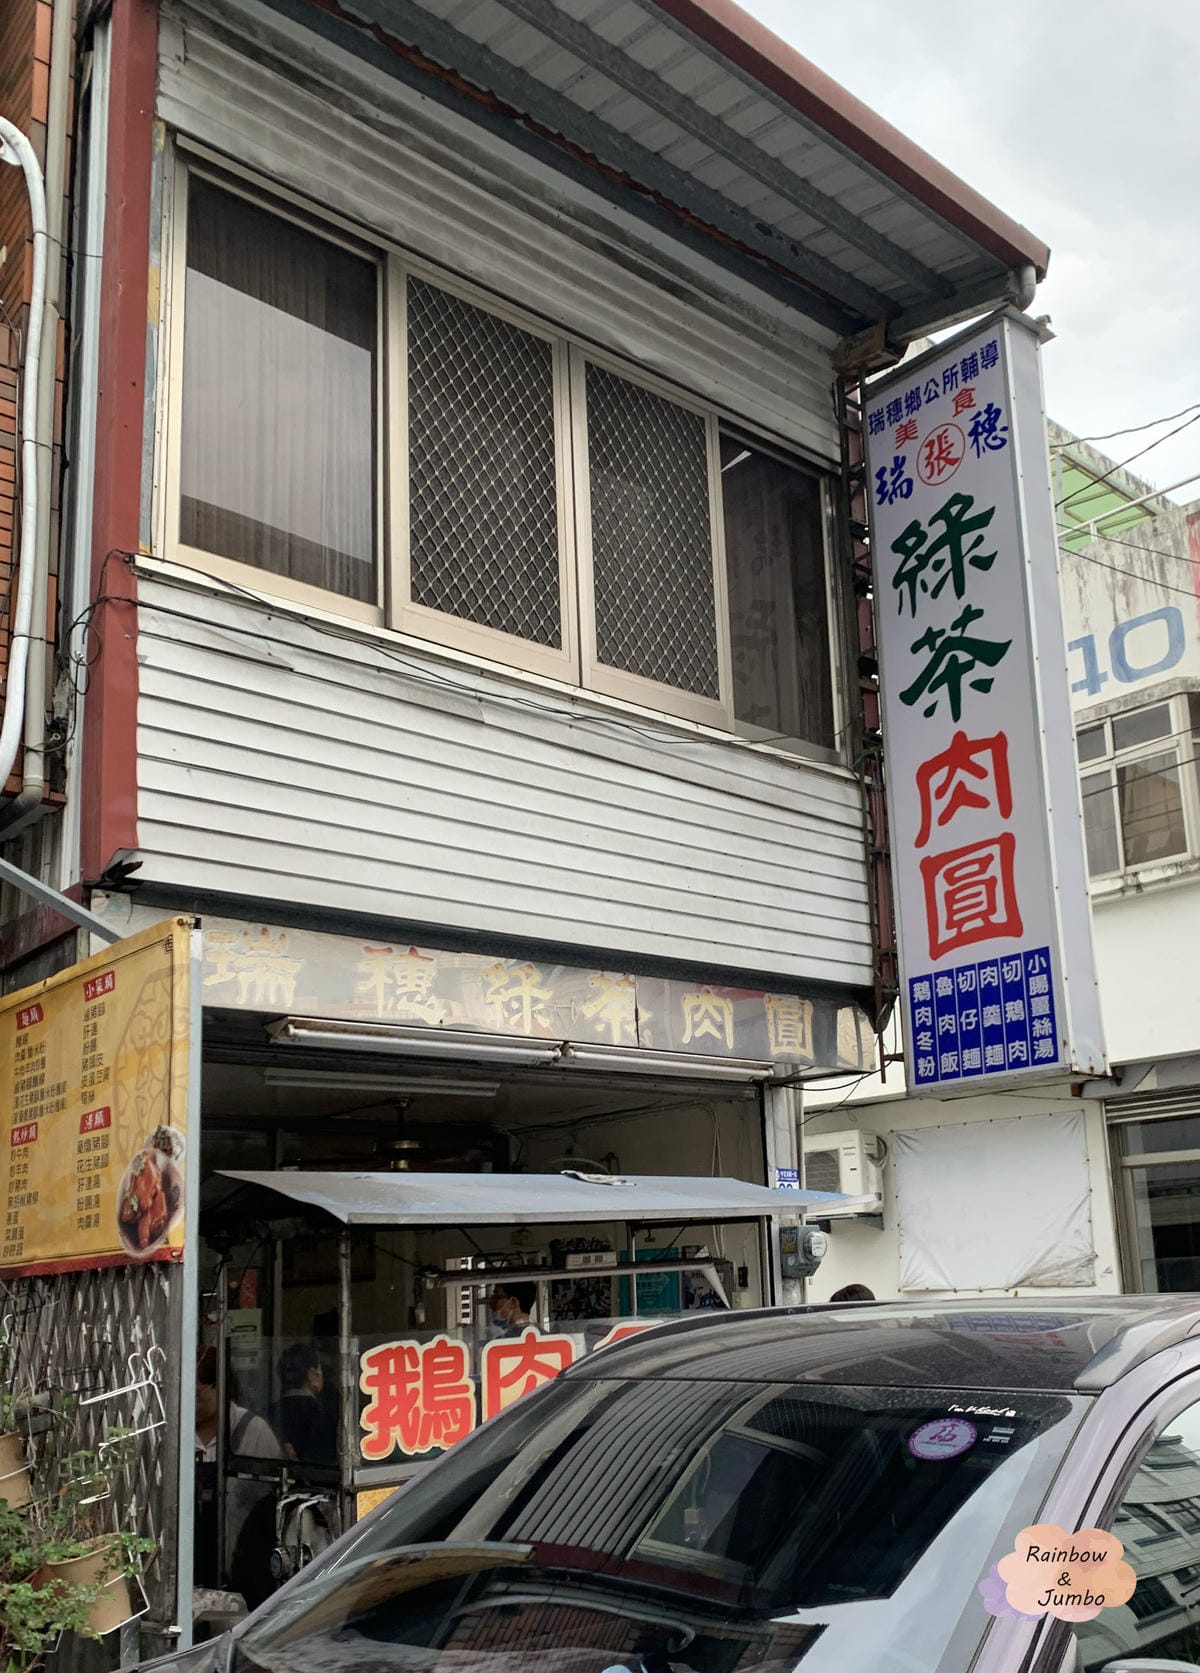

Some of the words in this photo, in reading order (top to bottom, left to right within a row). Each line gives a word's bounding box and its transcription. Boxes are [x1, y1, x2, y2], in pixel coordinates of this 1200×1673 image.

[867, 339, 1000, 436] 瑞穗鄉公所輔導
[924, 427, 961, 481] 張
[913, 981, 935, 1077] 鵝肉冬粉
[936, 976, 959, 1074] 魯肉飯
[957, 970, 982, 1070] 切仔麵
[1002, 959, 1026, 1062] 切鵝肉
[360, 1320, 665, 1460] 鵝肉
